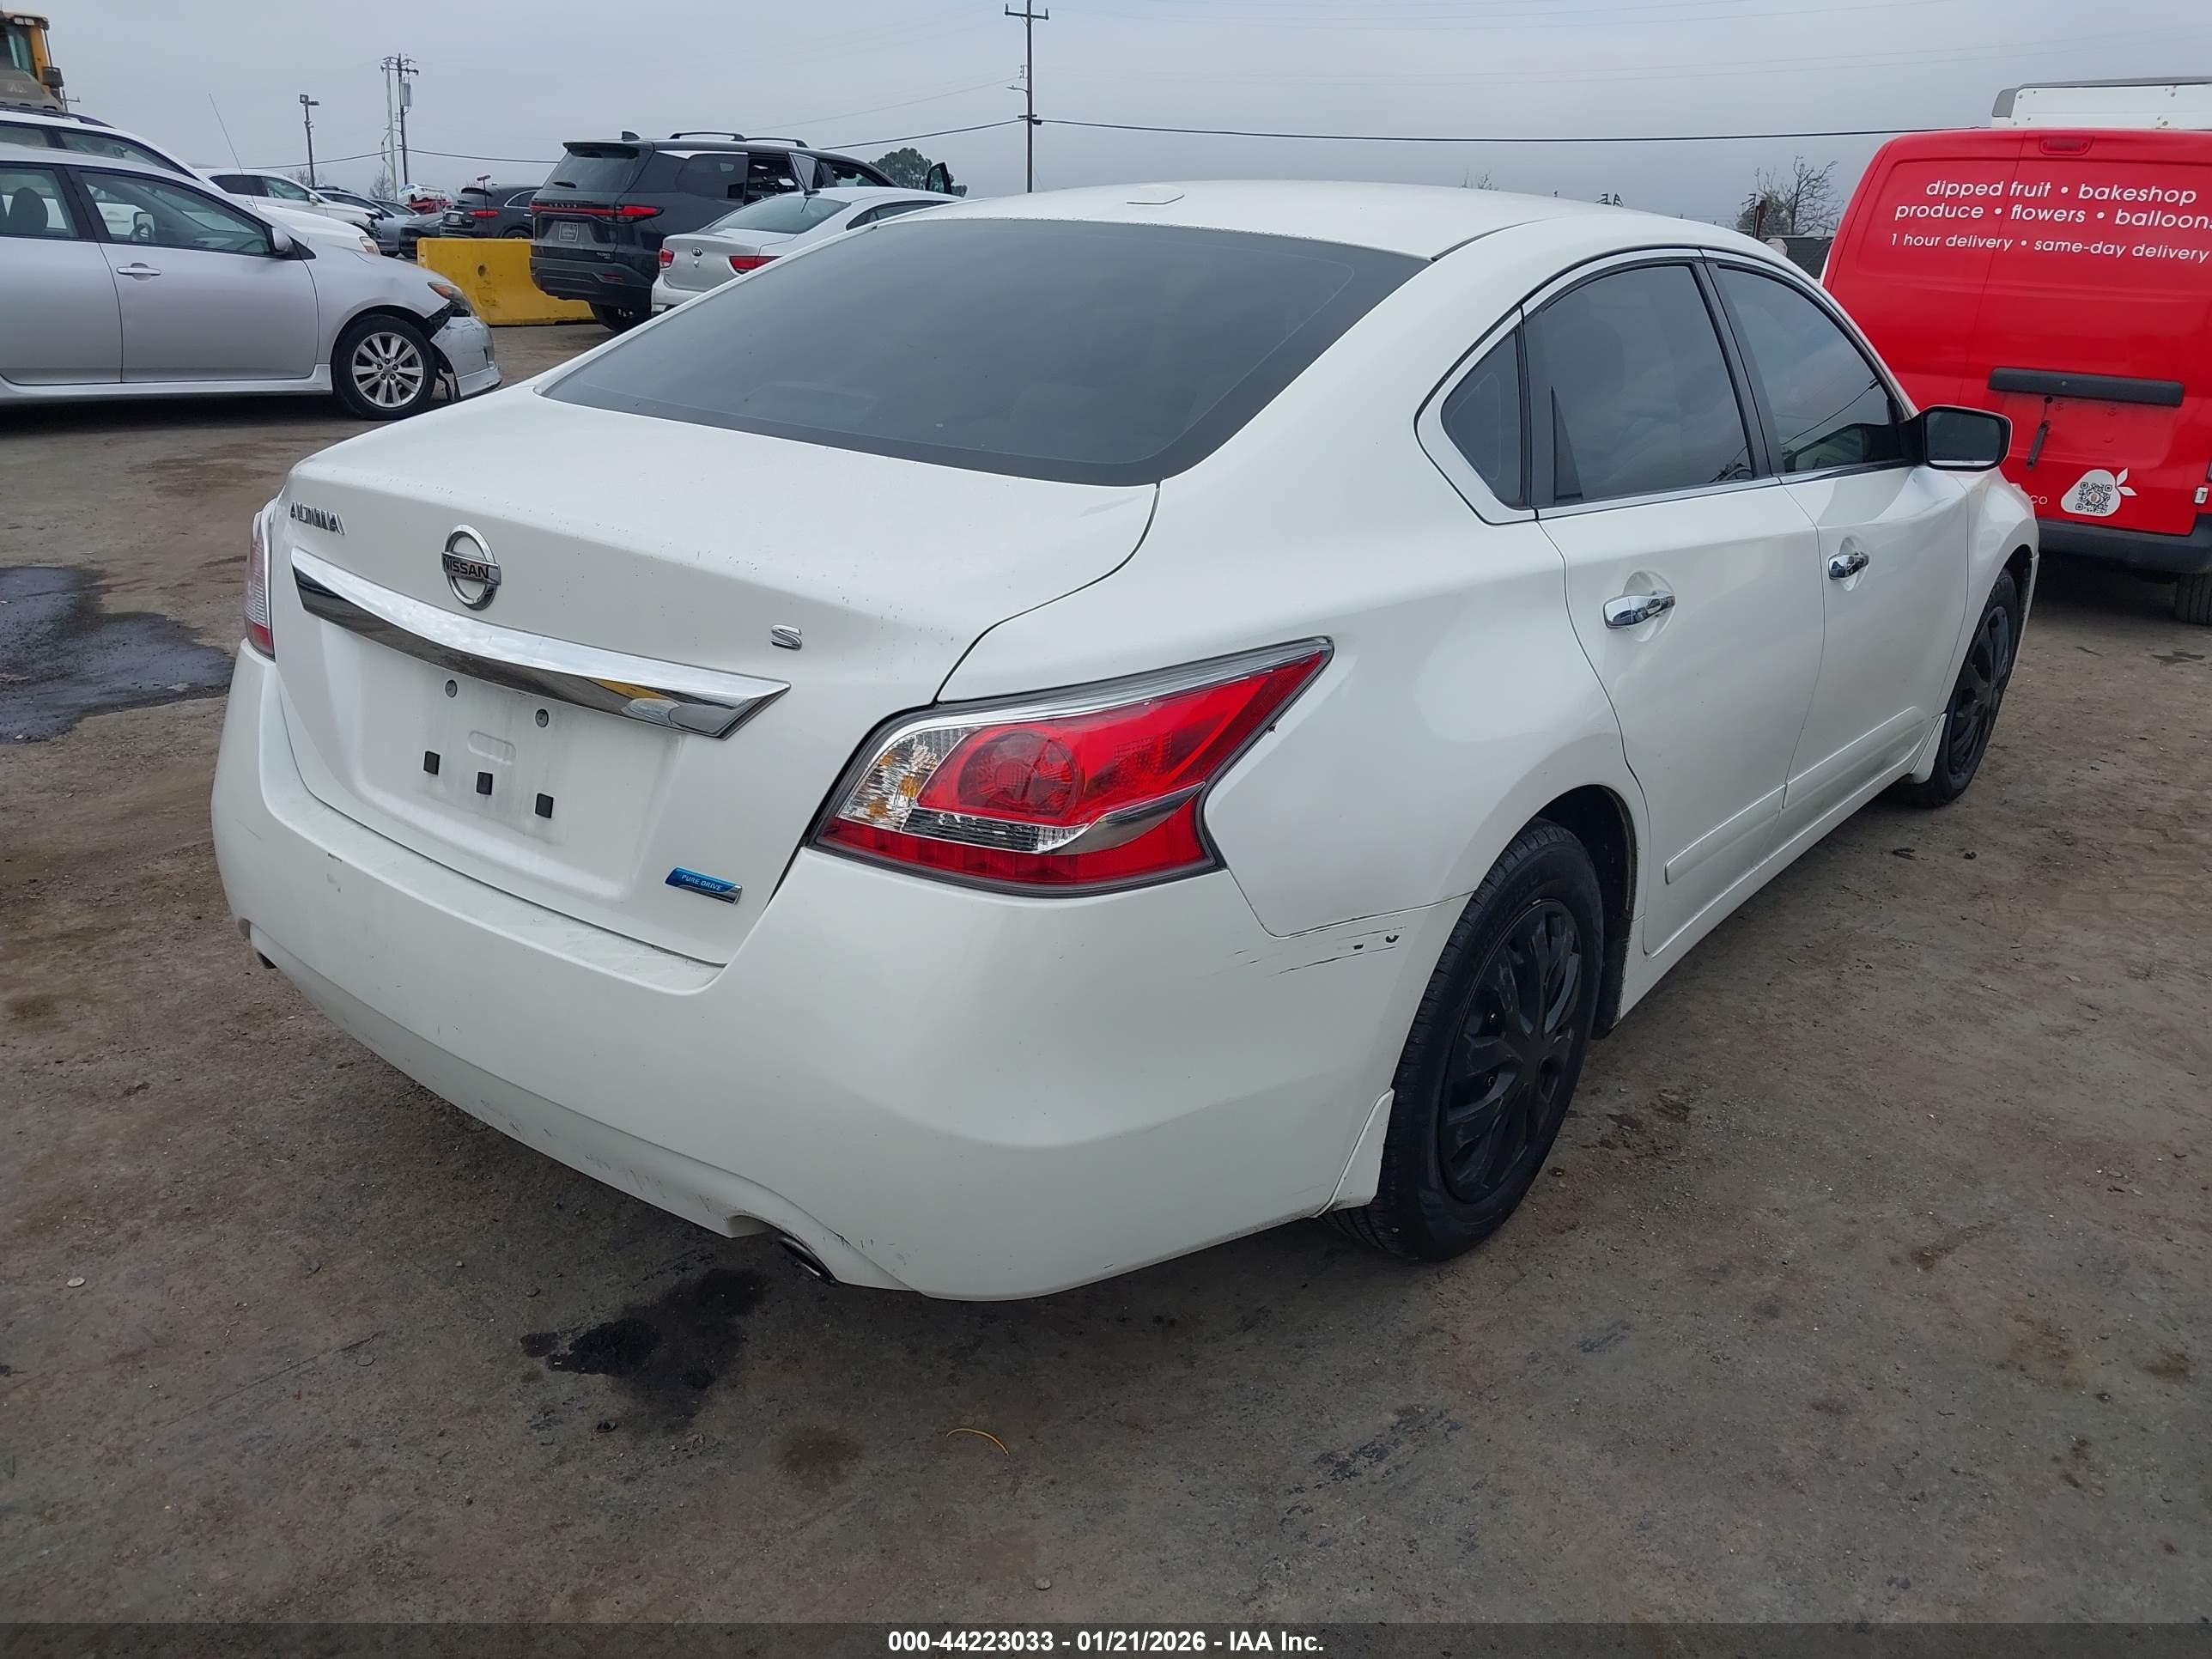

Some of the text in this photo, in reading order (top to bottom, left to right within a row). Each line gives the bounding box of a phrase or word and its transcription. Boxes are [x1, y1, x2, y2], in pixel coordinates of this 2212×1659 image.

[1926, 179, 2197, 207] dipped fruit bakeshop
[1894, 203, 2212, 230] produce flowers balloon
[1892, 233, 2210, 264] 1 hour delivery same-day delivery
[443, 556, 489, 580] NISSAN
[771, 624, 802, 651] S
[681, 874, 722, 891] PURE DRIVE
